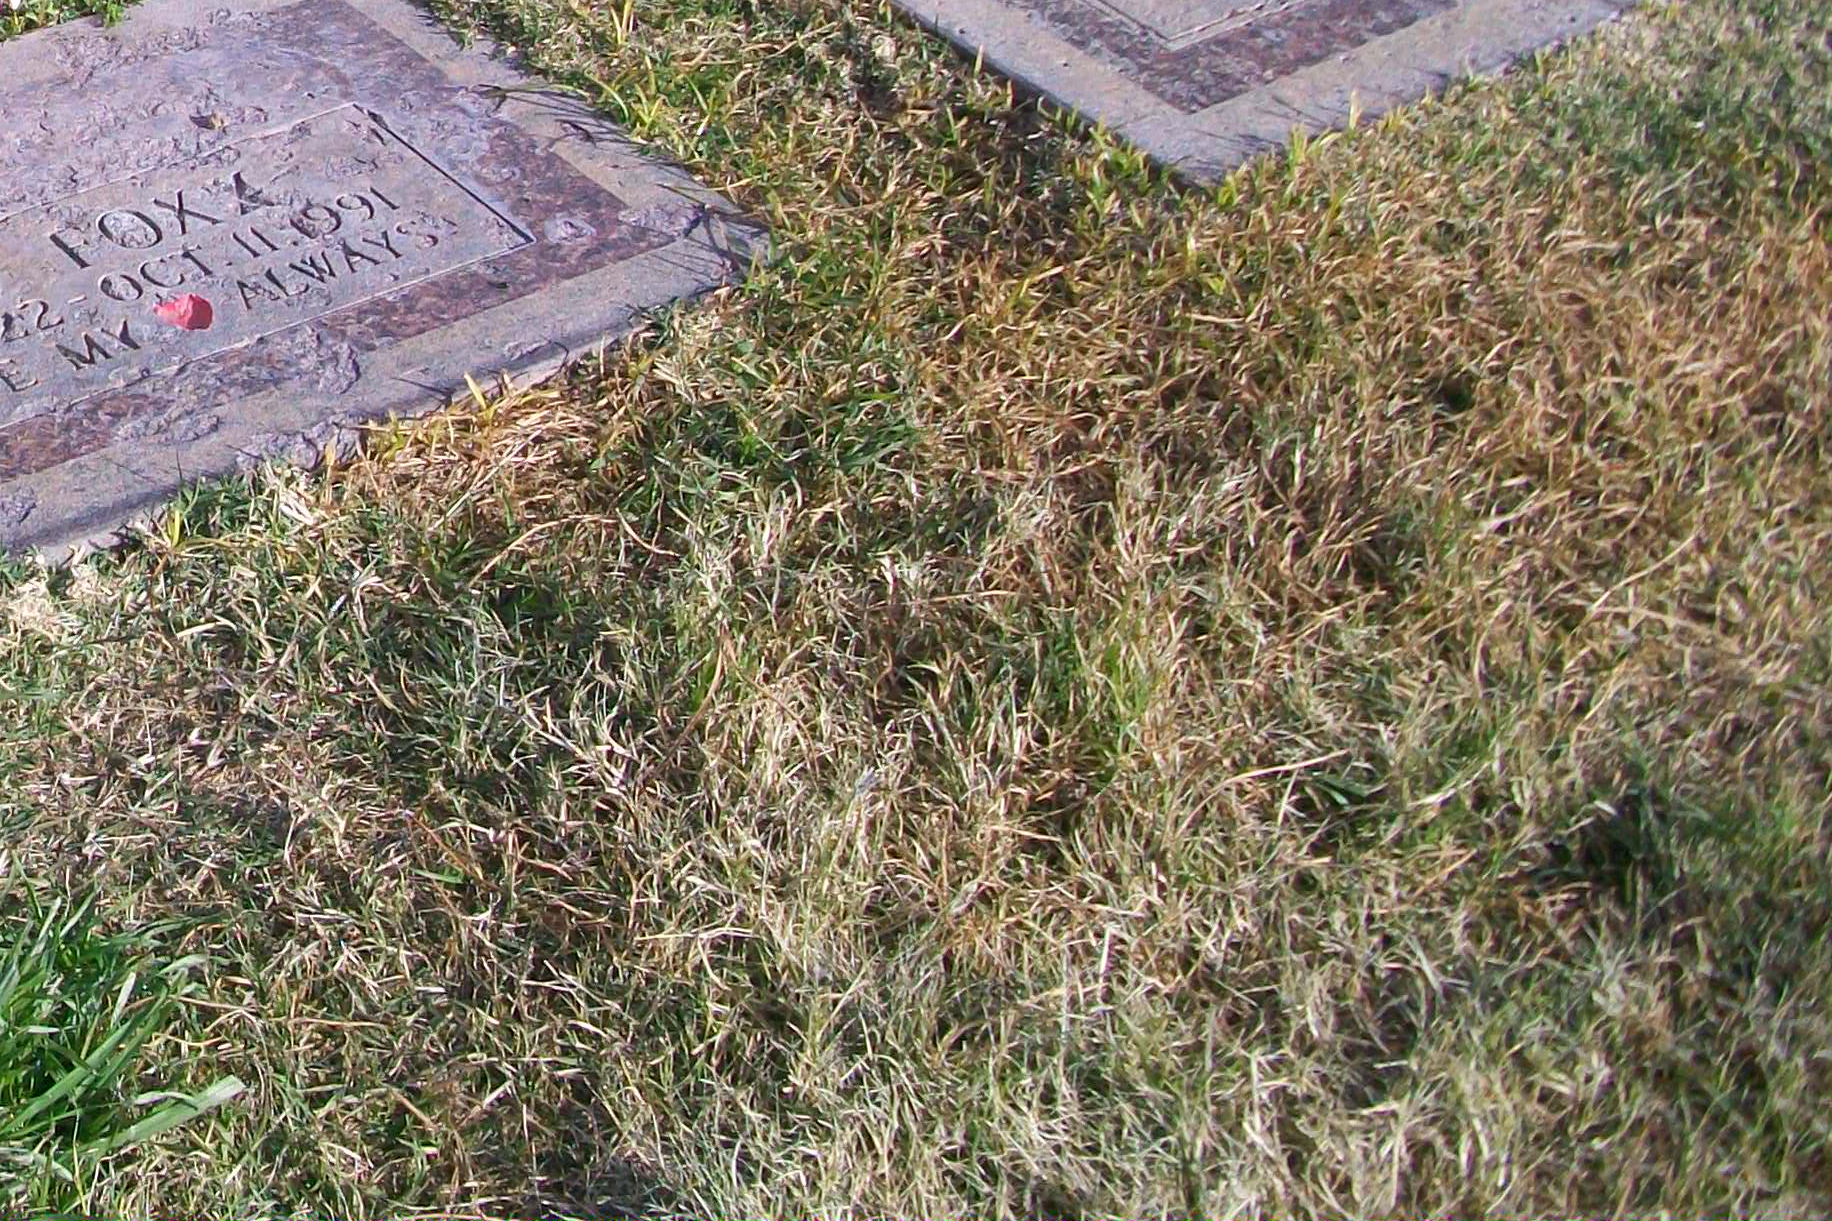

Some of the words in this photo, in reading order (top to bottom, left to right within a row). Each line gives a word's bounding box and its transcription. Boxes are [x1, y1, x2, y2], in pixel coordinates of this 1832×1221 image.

[288, 186, 401, 240] 1991
[53, 318, 142, 372] MY
[234, 217, 441, 311] ALWAYS
